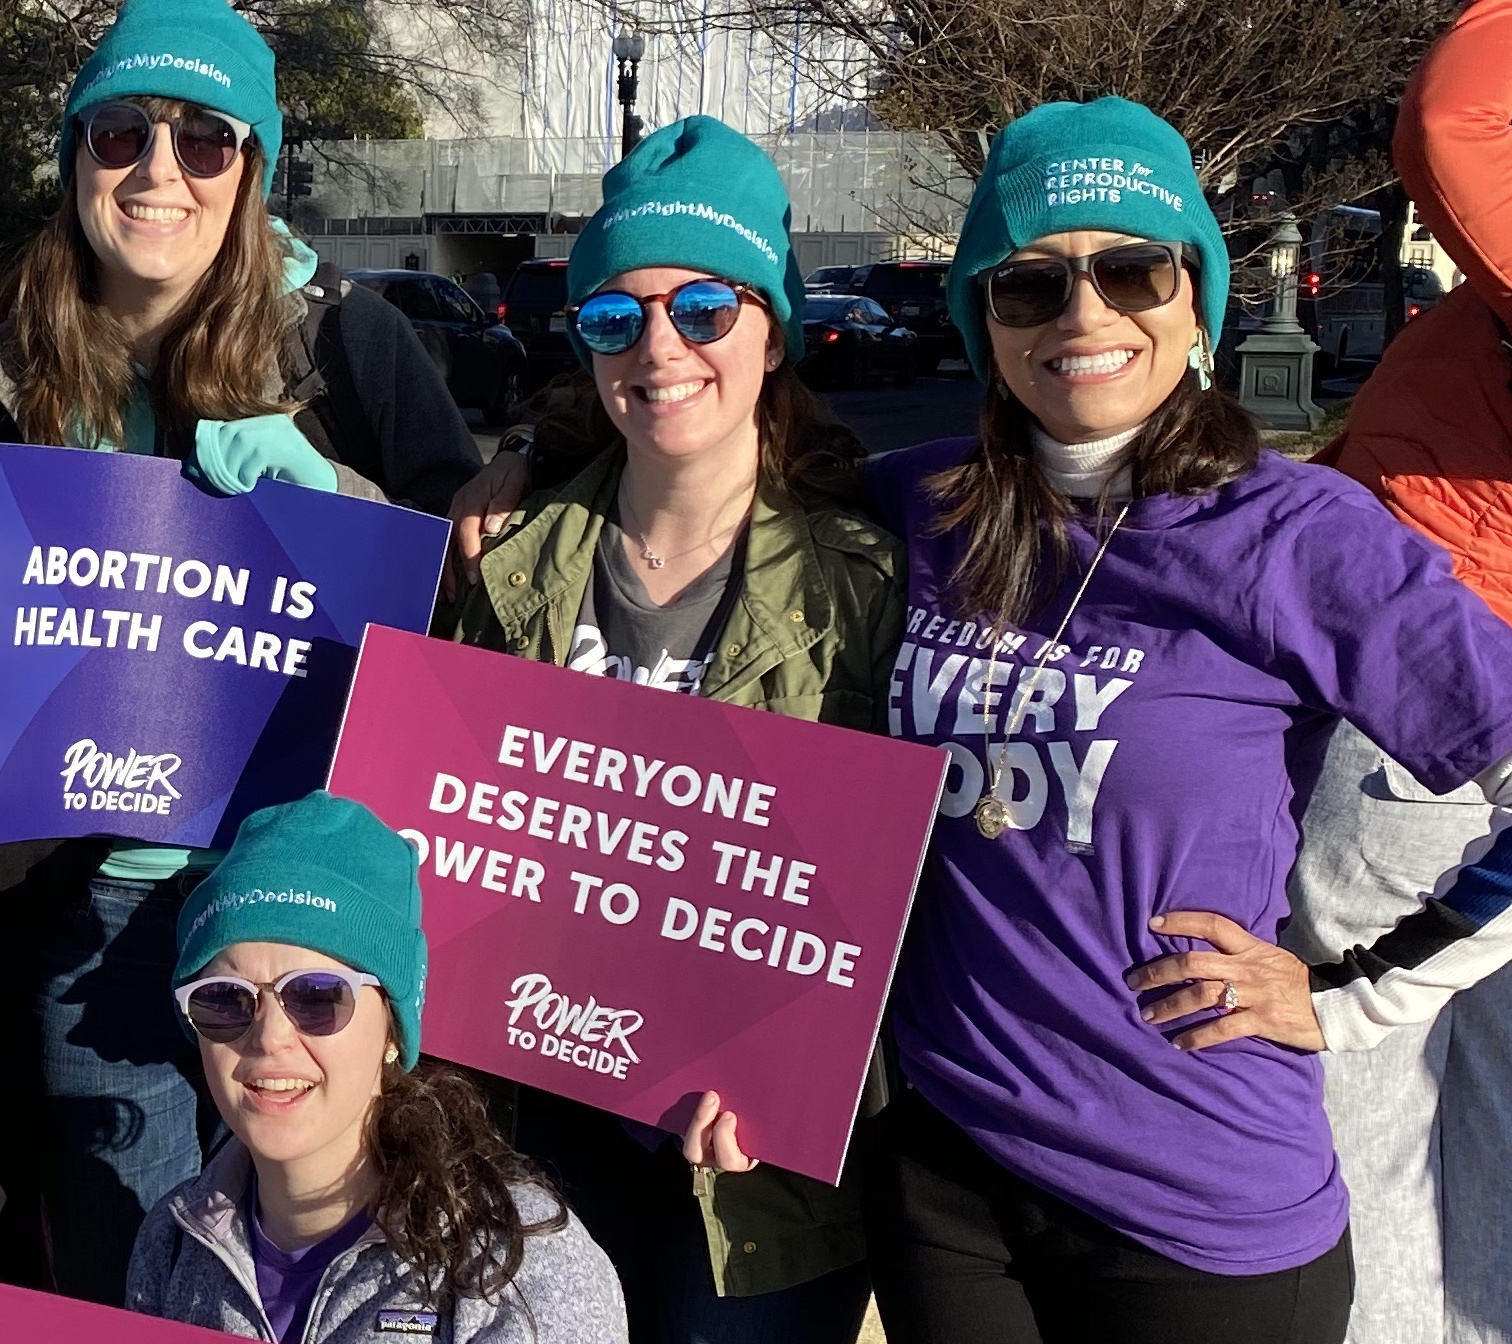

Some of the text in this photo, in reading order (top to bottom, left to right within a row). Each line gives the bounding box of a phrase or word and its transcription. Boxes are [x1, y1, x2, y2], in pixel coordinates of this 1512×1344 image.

[1045, 173, 1183, 212] REPRODUCTIVE
[1046, 158, 1154, 177] CENTER for
[1047, 188, 1121, 207] RIGHTS
[22, 545, 317, 619] ABORTION IS
[13, 606, 313, 678] HEALTH CARE
[907, 606, 1145, 674] REEDOM IS FOR
[888, 642, 1134, 737] EVERY
[59, 738, 183, 799] POWER
[63, 791, 173, 815] TO DECIDE
[497, 724, 777, 827] EVERYONE
[936, 740, 1119, 844] ODY
[428, 772, 817, 906] DESERVES THE
[396, 828, 862, 988] OWER TO DECIDE
[504, 974, 644, 1064] POWER
[507, 1026, 631, 1080] TO DECIDE
[380, 1320, 432, 1332] patagonia
